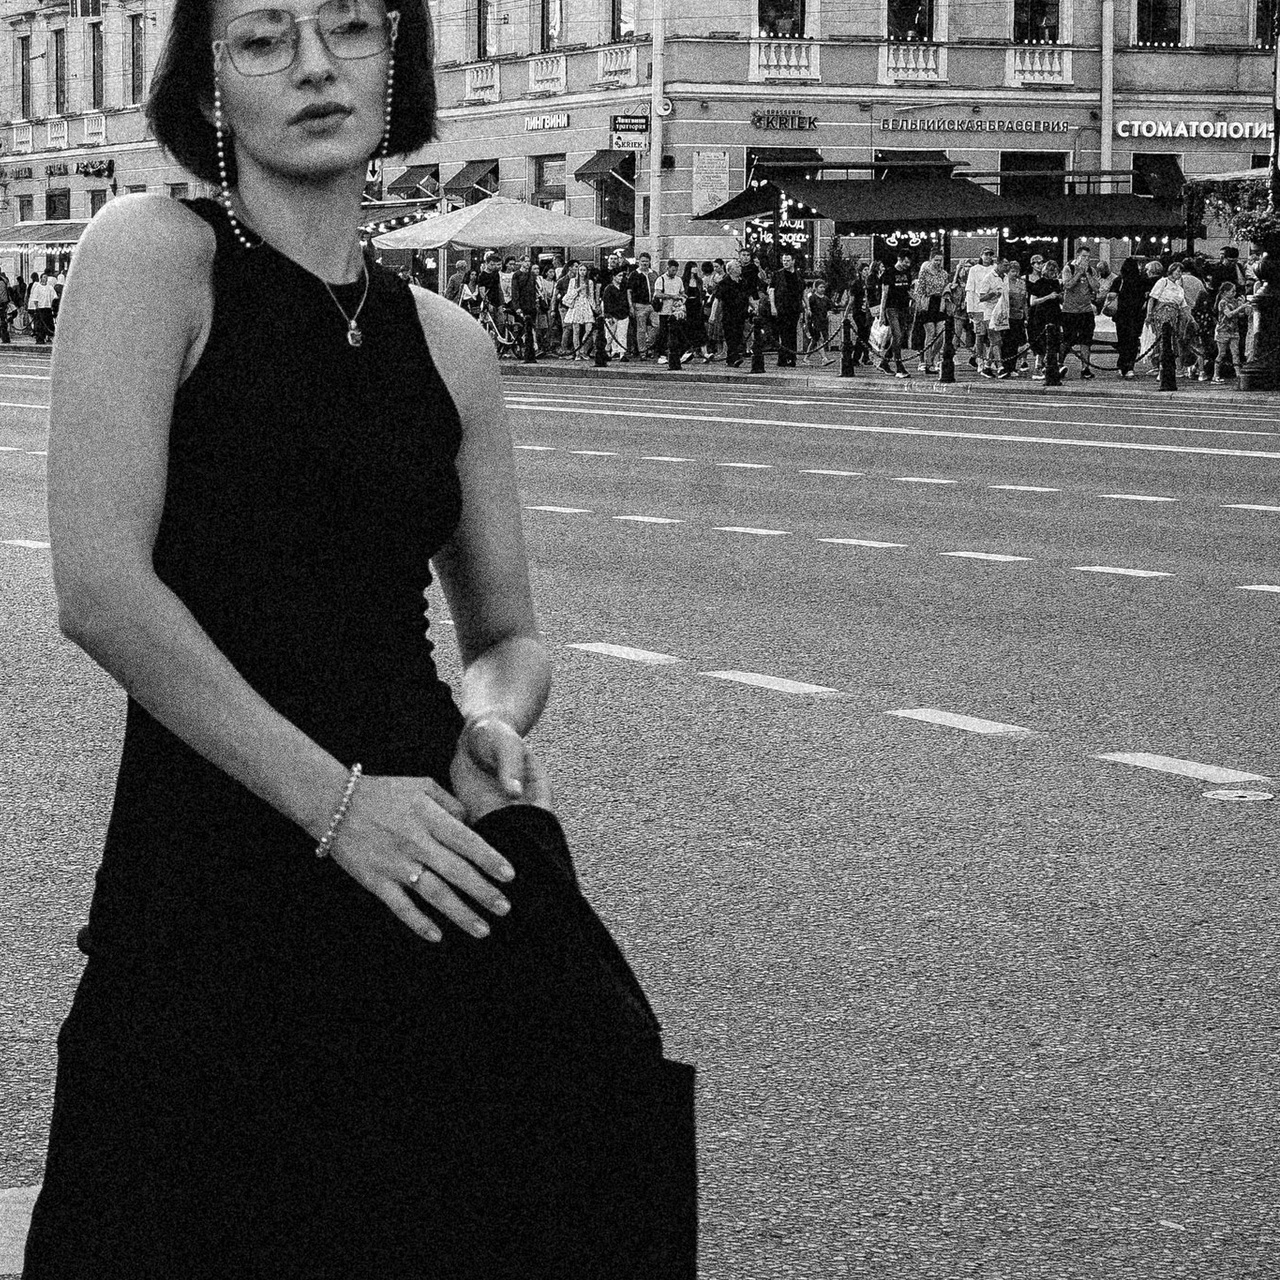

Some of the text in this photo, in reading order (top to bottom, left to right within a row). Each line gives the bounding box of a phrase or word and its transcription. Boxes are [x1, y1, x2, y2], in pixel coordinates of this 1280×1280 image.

[524, 114, 570, 132] ЛИНГВИНИ
[765, 116, 819, 131] KRIEK
[880, 117, 1069, 134] БЕЛЬГИЙСКАЯ БРАССЕРИЯ
[621, 141, 643, 149] KRIEK
